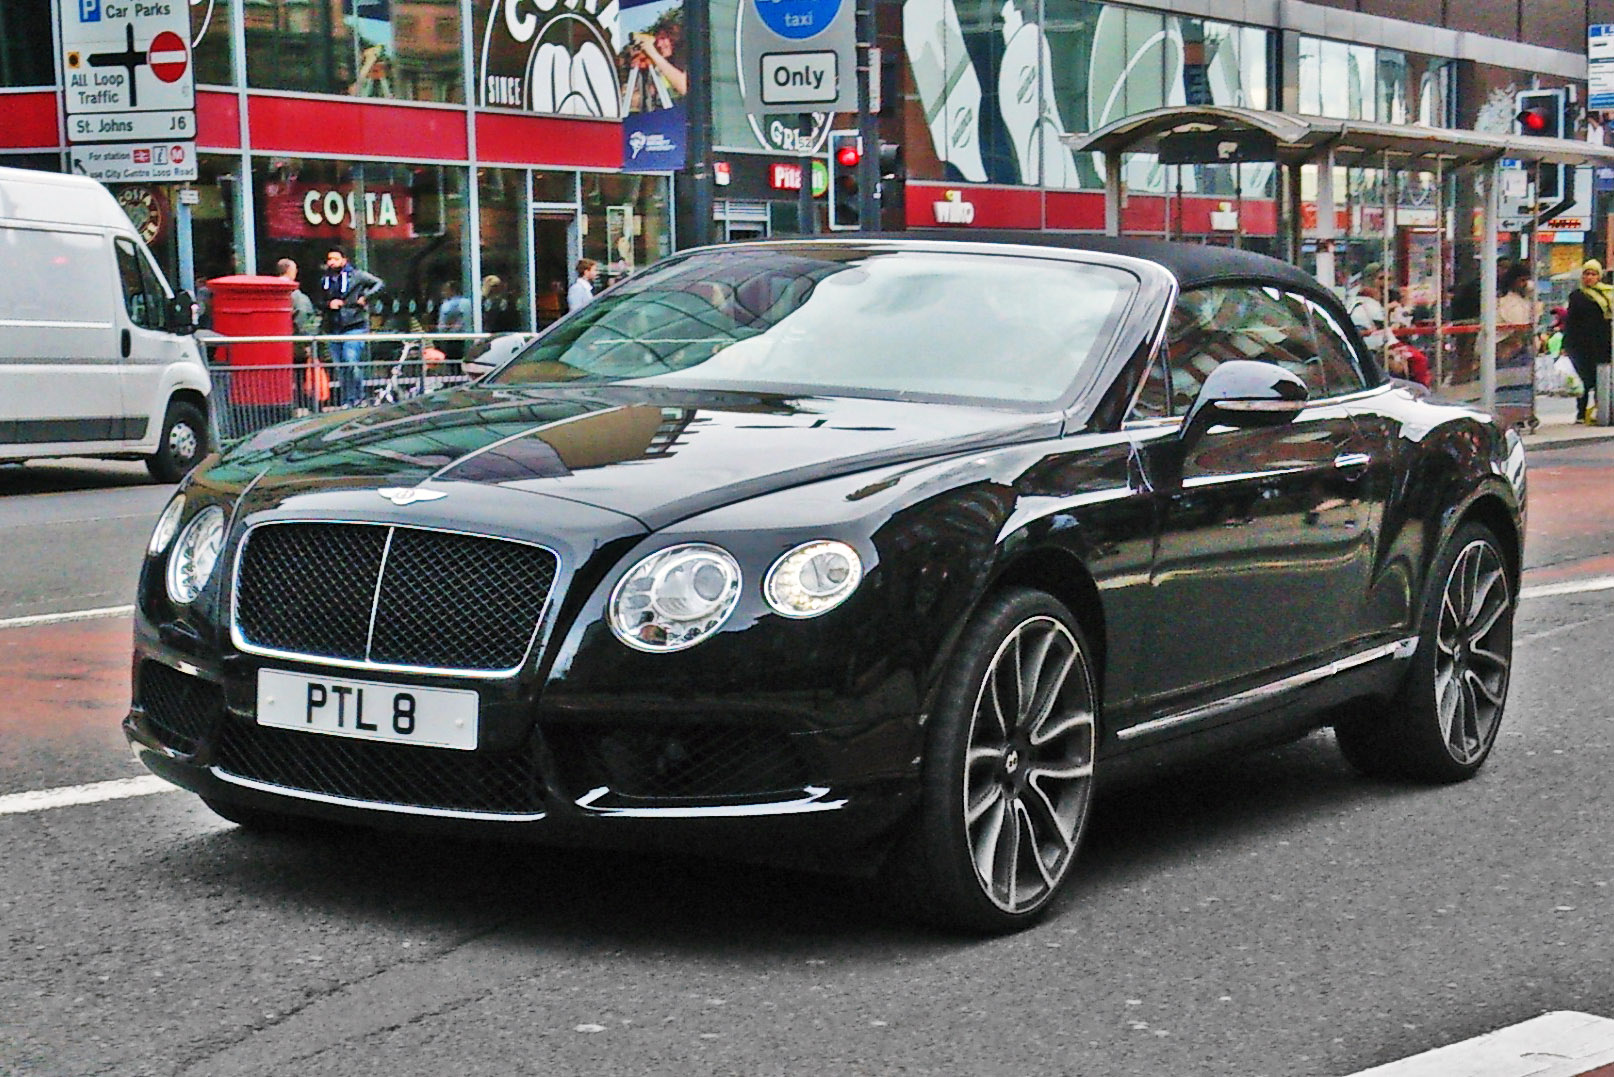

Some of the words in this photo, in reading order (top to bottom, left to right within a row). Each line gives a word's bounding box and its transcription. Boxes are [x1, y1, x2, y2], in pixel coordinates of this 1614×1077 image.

[105, 4, 128, 19] Car
[135, 3, 171, 17] Parks
[784, 11, 814, 27] taxi
[71, 74, 88, 87] All
[94, 73, 124, 87] Loop
[774, 65, 824, 89] Only
[78, 91, 119, 104] Traffic
[487, 75, 521, 105] SINCE
[76, 120, 94, 133] St.
[98, 119, 133, 132] Johns
[169, 116, 187, 130] J6
[103, 151, 131, 160] station
[104, 168, 120, 179] City
[123, 168, 150, 178] Centre
[152, 168, 171, 177] Loop
[174, 167, 194, 176] Road
[306, 682, 378, 732] PTL
[392, 692, 416, 735] 8
